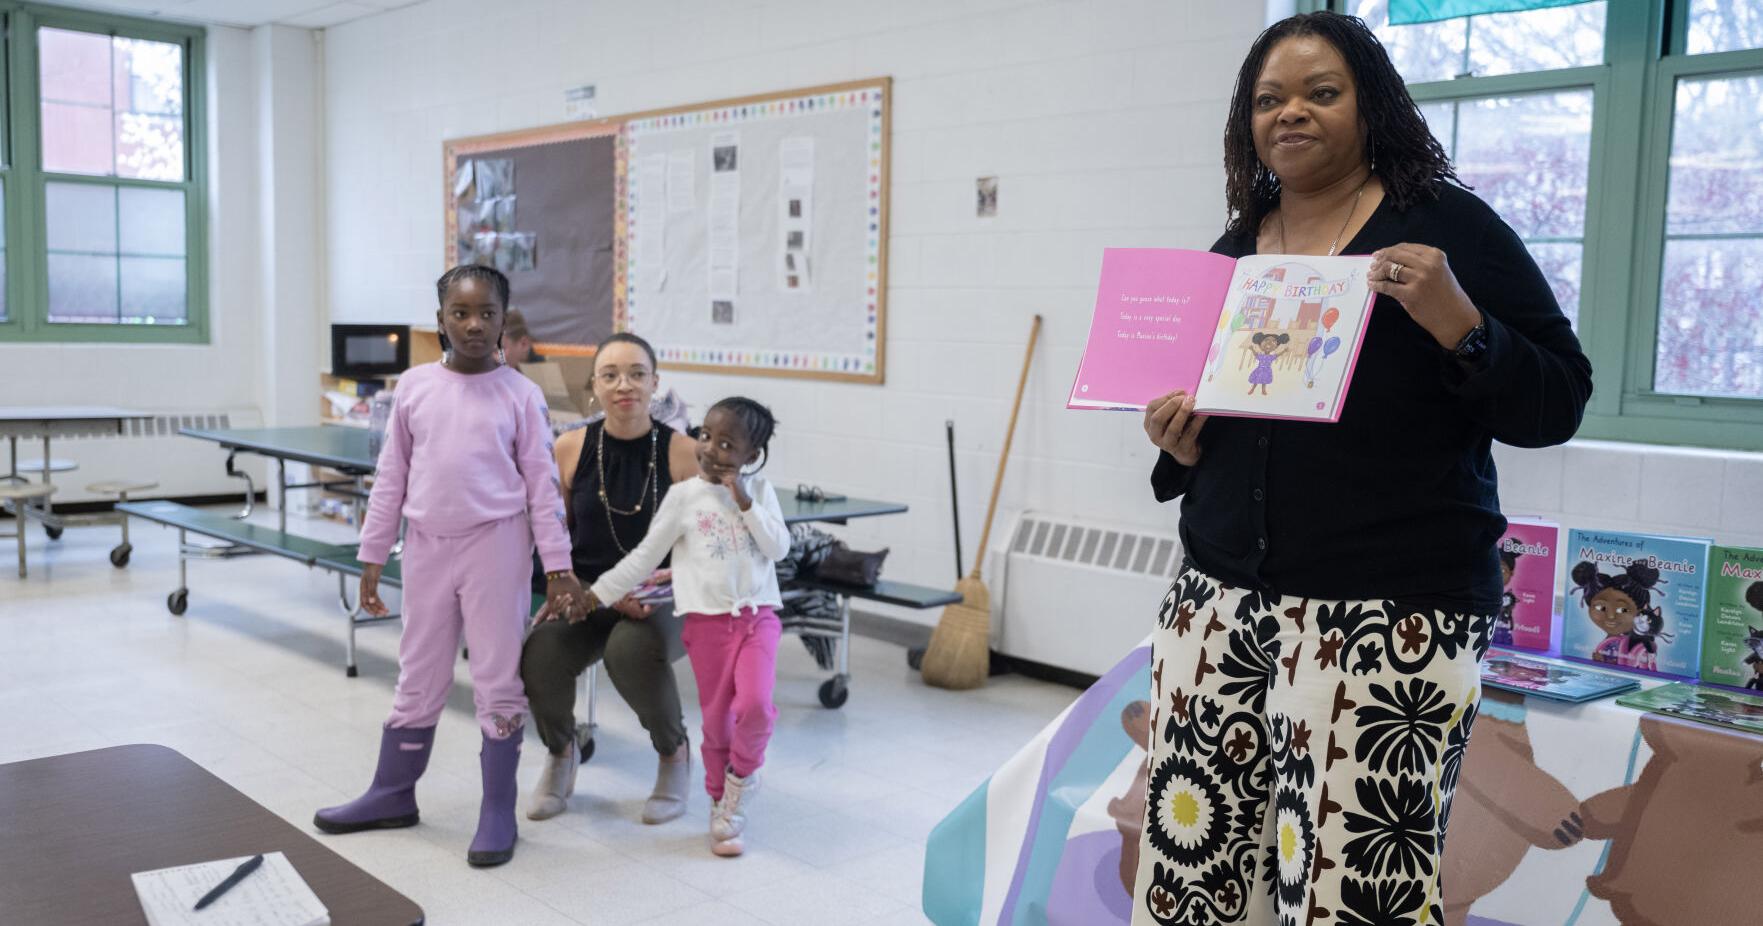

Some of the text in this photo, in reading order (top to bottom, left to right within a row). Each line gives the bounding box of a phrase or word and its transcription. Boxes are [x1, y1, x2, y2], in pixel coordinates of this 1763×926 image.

[1243, 278, 1345, 297] HAPPY BIRTHDAY
[1503, 539, 1549, 557] Beanie
[1577, 532, 1645, 552] The Adventures of
[1579, 547, 1633, 565] Maxine
[1647, 555, 1696, 574] Beanie
[1723, 550, 1738, 560] The
